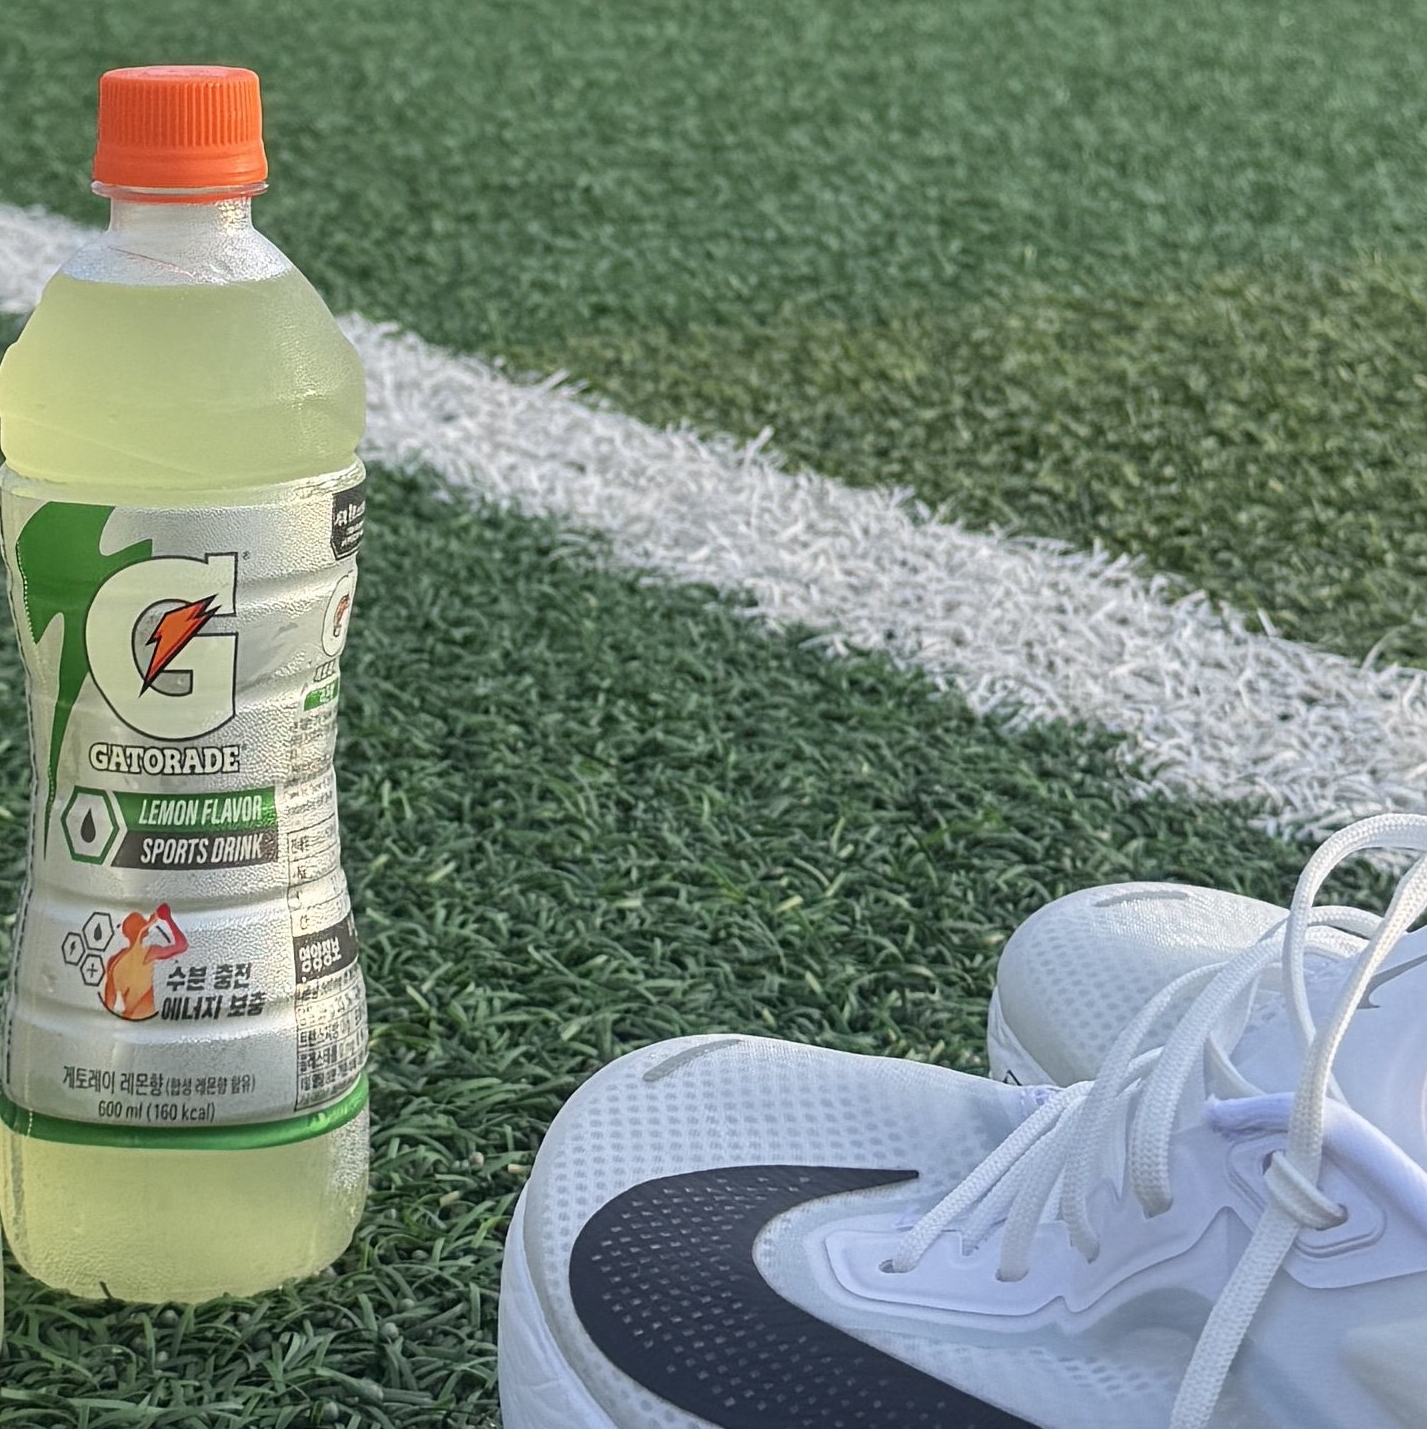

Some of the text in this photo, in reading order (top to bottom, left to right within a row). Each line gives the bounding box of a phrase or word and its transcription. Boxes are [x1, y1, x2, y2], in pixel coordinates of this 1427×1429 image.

[85, 552, 238, 742] G
[89, 742, 240, 774] GATORADE
[138, 796, 263, 827] LEMON FLAVOR
[140, 836, 208, 865] SPORTS
[211, 833, 264, 863] DRINK
[298, 936, 342, 973] 영양정보
[166, 963, 252, 992] 수분 충전
[161, 994, 221, 1022] 에너지
[226, 992, 266, 1018] 보충
[62, 1065, 116, 1095] 게토레이
[120, 1072, 164, 1097] 레몬향
[98, 1100, 216, 1122] 600 ml (160 kcal)
